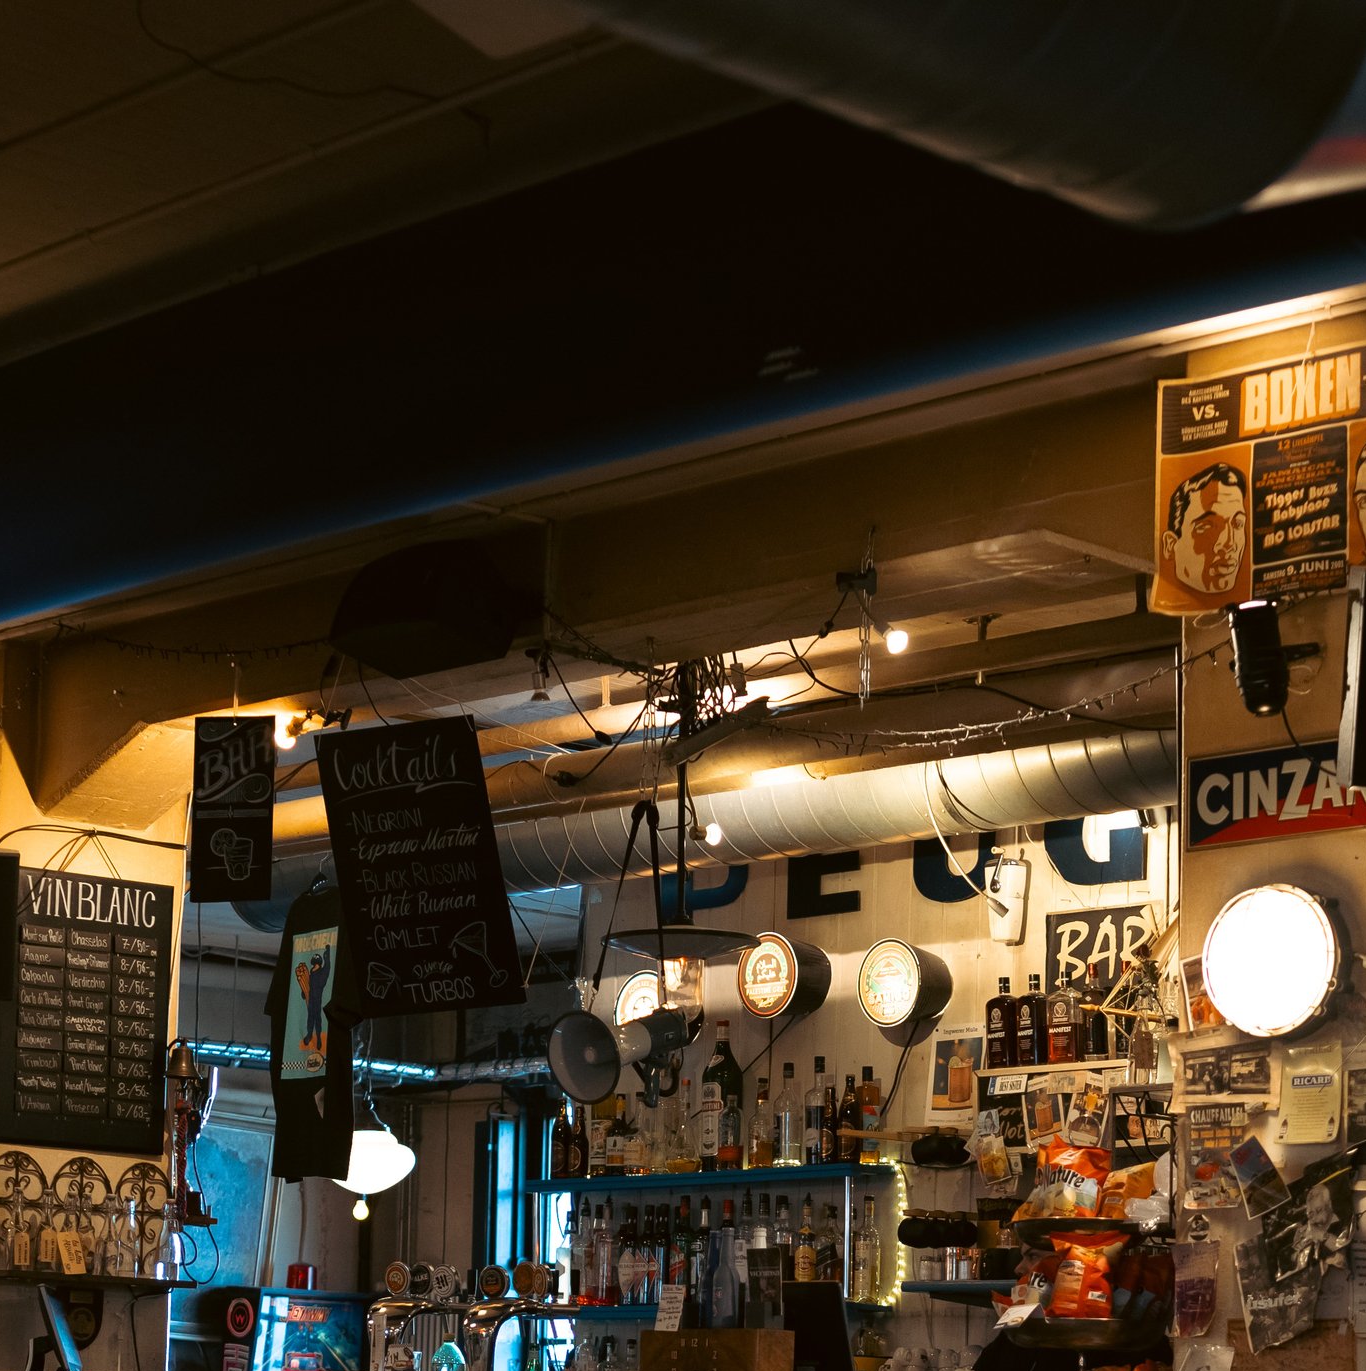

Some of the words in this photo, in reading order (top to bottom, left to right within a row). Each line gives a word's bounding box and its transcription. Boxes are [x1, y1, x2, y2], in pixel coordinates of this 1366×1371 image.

[1240, 352, 1361, 435] BOXEN
[1192, 404, 1220, 421] VS.
[1278, 439, 1290, 451] 12
[1265, 487, 1305, 510] Tigger
[1287, 514, 1340, 540] LOBSTAR
[1287, 565, 1297, 577] 9.
[1299, 560, 1329, 574] JUNI
[196, 724, 273, 798] BAR
[422, 824, 481, 851] Martini
[412, 861, 478, 887] RUSSIAN
[27, 875, 72, 919] VIN
[76, 882, 156, 928] BLANC
[417, 887, 476, 915] Russian
[72, 931, 108, 948] Chasselas
[1055, 914, 1153, 987] BAR
[69, 973, 106, 989] Verdicchio
[403, 976, 476, 1004] TURBOS
[943, 1027, 965, 1035] Ingwerer
[966, 1026, 978, 1034] Mule
[988, 1031, 1005, 1039] MANIFEST
[1048, 1026, 1072, 1034] MANIFEST
[20, 1054, 58, 1069] Trimbach
[1293, 1075, 1332, 1086] RICARD
[1043, 1165, 1085, 1191] Nature
[691, 1338, 698, 1347] 12
[712, 1351, 717, 1360] 2
